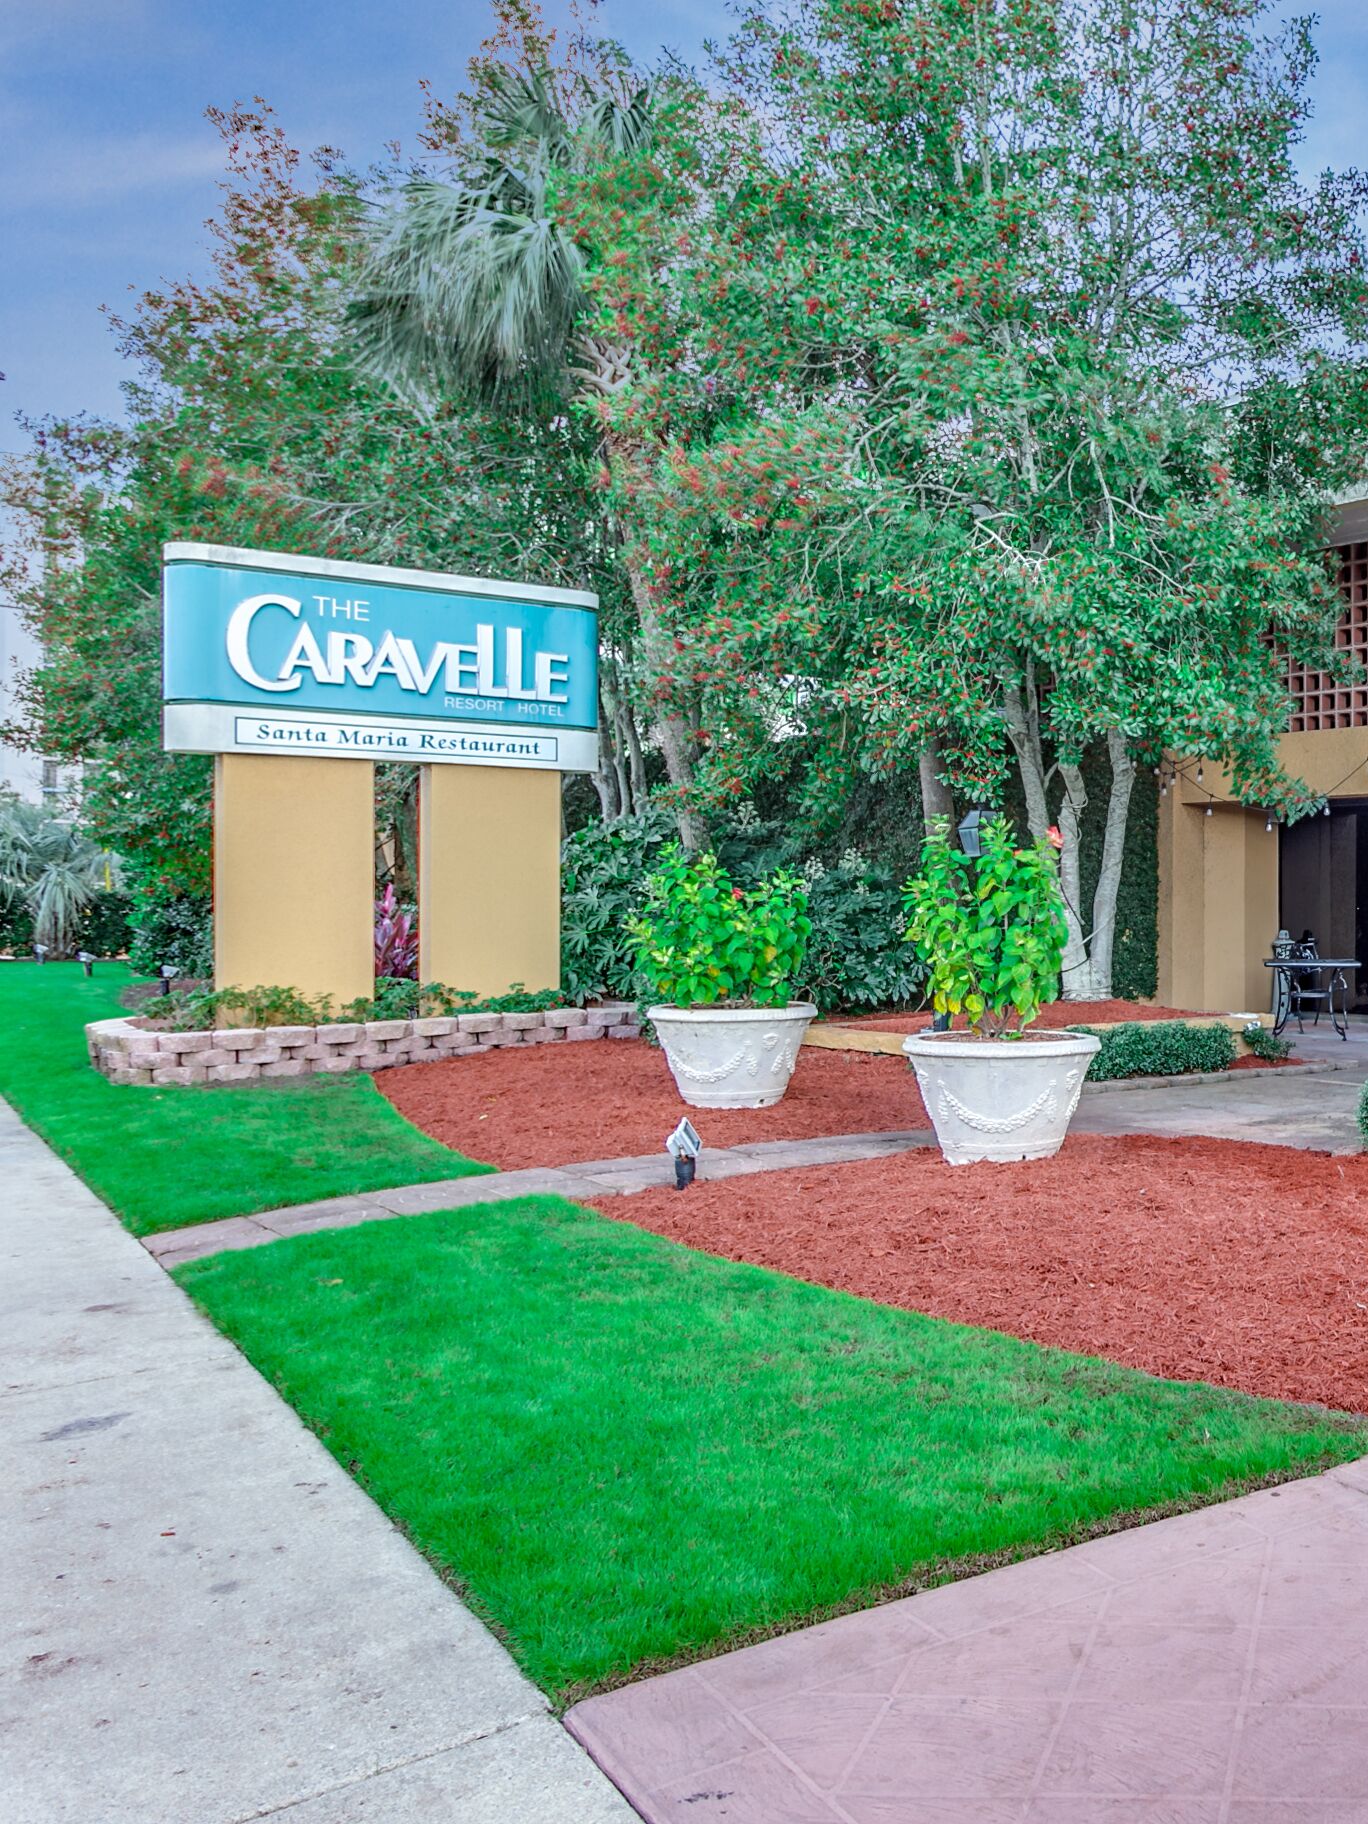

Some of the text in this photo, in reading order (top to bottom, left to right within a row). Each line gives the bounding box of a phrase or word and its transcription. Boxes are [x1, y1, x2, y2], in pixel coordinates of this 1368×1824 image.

[312, 595, 371, 622] THE
[225, 593, 569, 704] CARAVELLE
[444, 697, 565, 717] RESORT HOTEL
[256, 723, 542, 755] Santa Maria Restaurant
